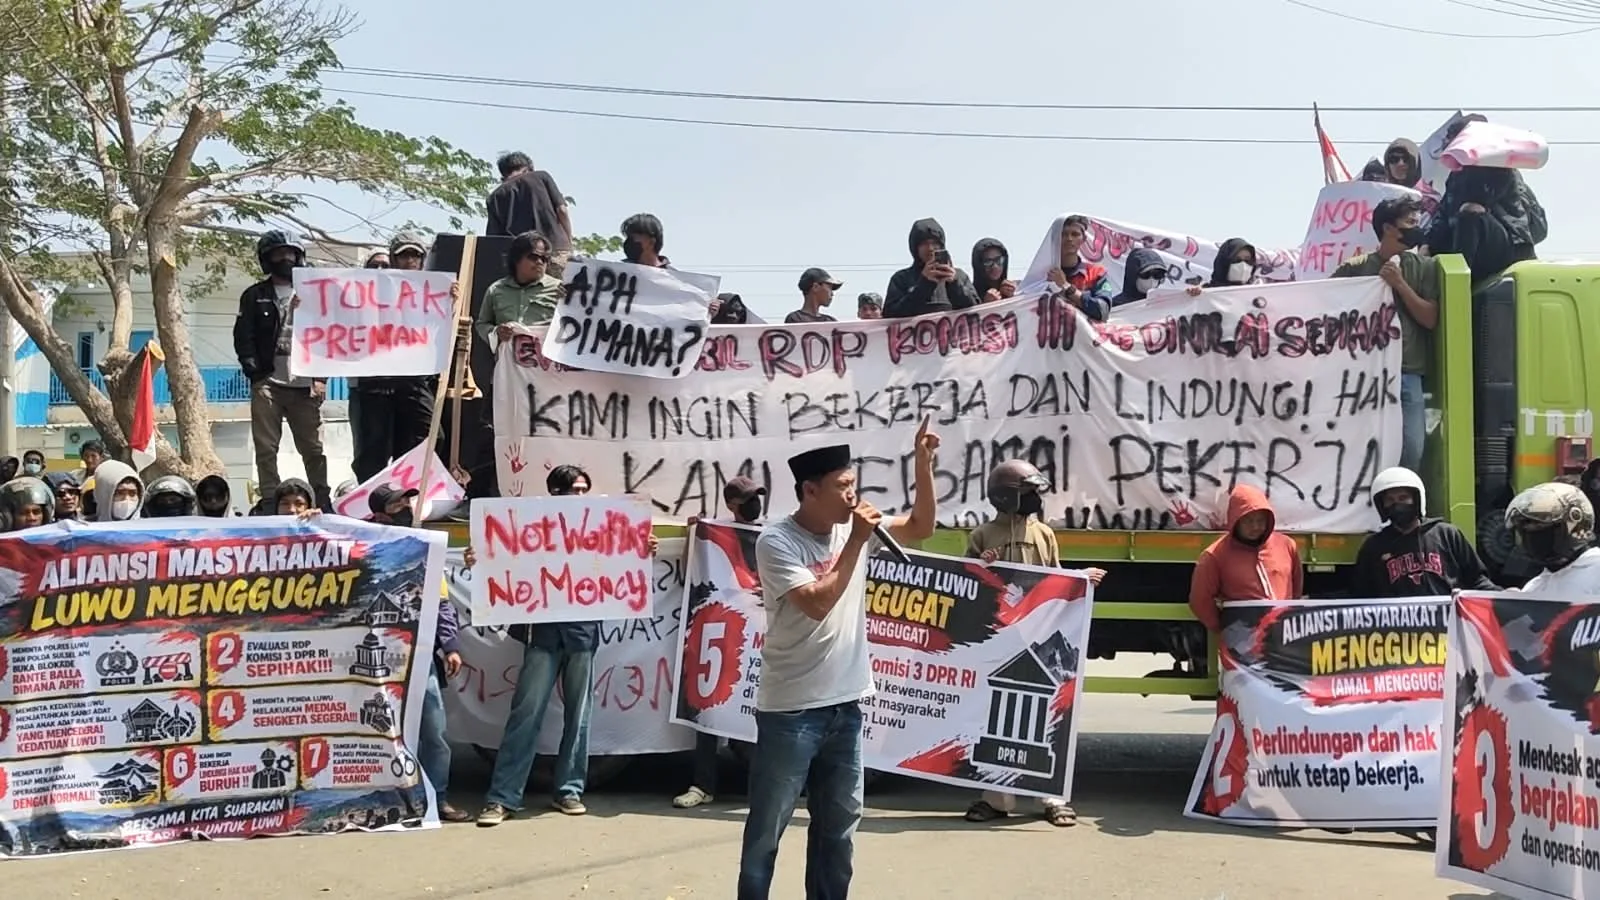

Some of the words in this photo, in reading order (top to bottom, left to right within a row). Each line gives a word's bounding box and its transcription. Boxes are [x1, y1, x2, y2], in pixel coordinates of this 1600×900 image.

[302, 278, 448, 319] TOLAK
[564, 265, 637, 315] APH
[302, 322, 429, 364] PREMAN
[758, 328, 868, 382] RDP
[887, 311, 1019, 364] KOMISI
[527, 383, 630, 438] KAMI
[650, 392, 758, 441] INGIN
[782, 377, 991, 441] BEKERJA
[1006, 369, 1091, 417] DAN
[1335, 367, 1398, 418] HAK
[1109, 433, 1380, 511] PEKERJA
[484, 508, 557, 558] Not
[38, 550, 158, 592] ALIANSI
[168, 540, 355, 578] MASYARAKAT
[934, 570, 979, 600] LUWU
[31, 586, 136, 632] LUWU
[145, 569, 361, 617] MENGGUGAT
[866, 580, 955, 629] GGUGAT
[1282, 609, 1339, 645] ALIANSI
[1343, 604, 1438, 630] MASYARAKAT
[44, 643, 70, 651] POLRES
[71, 640, 90, 649] LUWU
[218, 637, 235, 665] 2
[246, 652, 282, 663] KOMISI
[285, 651, 292, 660] 3
[295, 650, 315, 660] DPR
[318, 649, 329, 658] RI
[247, 642, 289, 651] EVALUASI
[292, 640, 311, 649] RDP
[1311, 631, 1449, 676] MENGGUGA
[13, 664, 35, 673] BUKA
[38, 660, 75, 671] BLOKADE
[246, 659, 333, 678] SEPIHAK!!!
[697, 622, 726, 698] 5
[13, 672, 47, 684] RANTE
[50, 669, 82, 679] BALLA
[13, 683, 55, 695] DIMANA
[58, 680, 85, 690] APH?
[913, 661, 923, 681] 3
[926, 663, 958, 686] DPR
[961, 669, 977, 688] RI
[1331, 676, 1372, 699] (AMAL
[1374, 672, 1444, 693] MENGGUGA
[884, 680, 960, 706] kewenangan
[218, 696, 236, 720] 4
[252, 705, 302, 715] MELAKUKAN
[304, 702, 347, 713] MEDIASI
[253, 715, 308, 727] SENGKETA
[872, 711, 906, 729] Luwu
[879, 698, 947, 720] masyarakat
[17, 731, 43, 742] YANG
[17, 740, 68, 753] KEDATUAN
[1252, 725, 1364, 760] Perlindungan
[1368, 724, 1400, 749] dan
[1404, 723, 1437, 751] hak
[173, 752, 189, 779] 6
[309, 743, 322, 768] 7
[997, 746, 1017, 763] DPR
[1017, 750, 1027, 765] RI
[1212, 712, 1236, 798] 2
[1519, 739, 1583, 777] Mendesak
[200, 778, 240, 792] BURUH
[1257, 762, 1301, 787] untuk
[1305, 764, 1351, 793] tetap
[1355, 760, 1425, 791] bekerja.
[1474, 729, 1496, 850] 3
[122, 810, 186, 832] BERSAMA
[191, 806, 219, 822] KITA
[224, 797, 285, 818] SUARAKAN
[1520, 772, 1599, 832] berjalan
[205, 820, 247, 835] UNTUK
[251, 815, 285, 831] LUWU
[1521, 826, 1541, 857] dan
[1543, 838, 1600, 872] operasion
